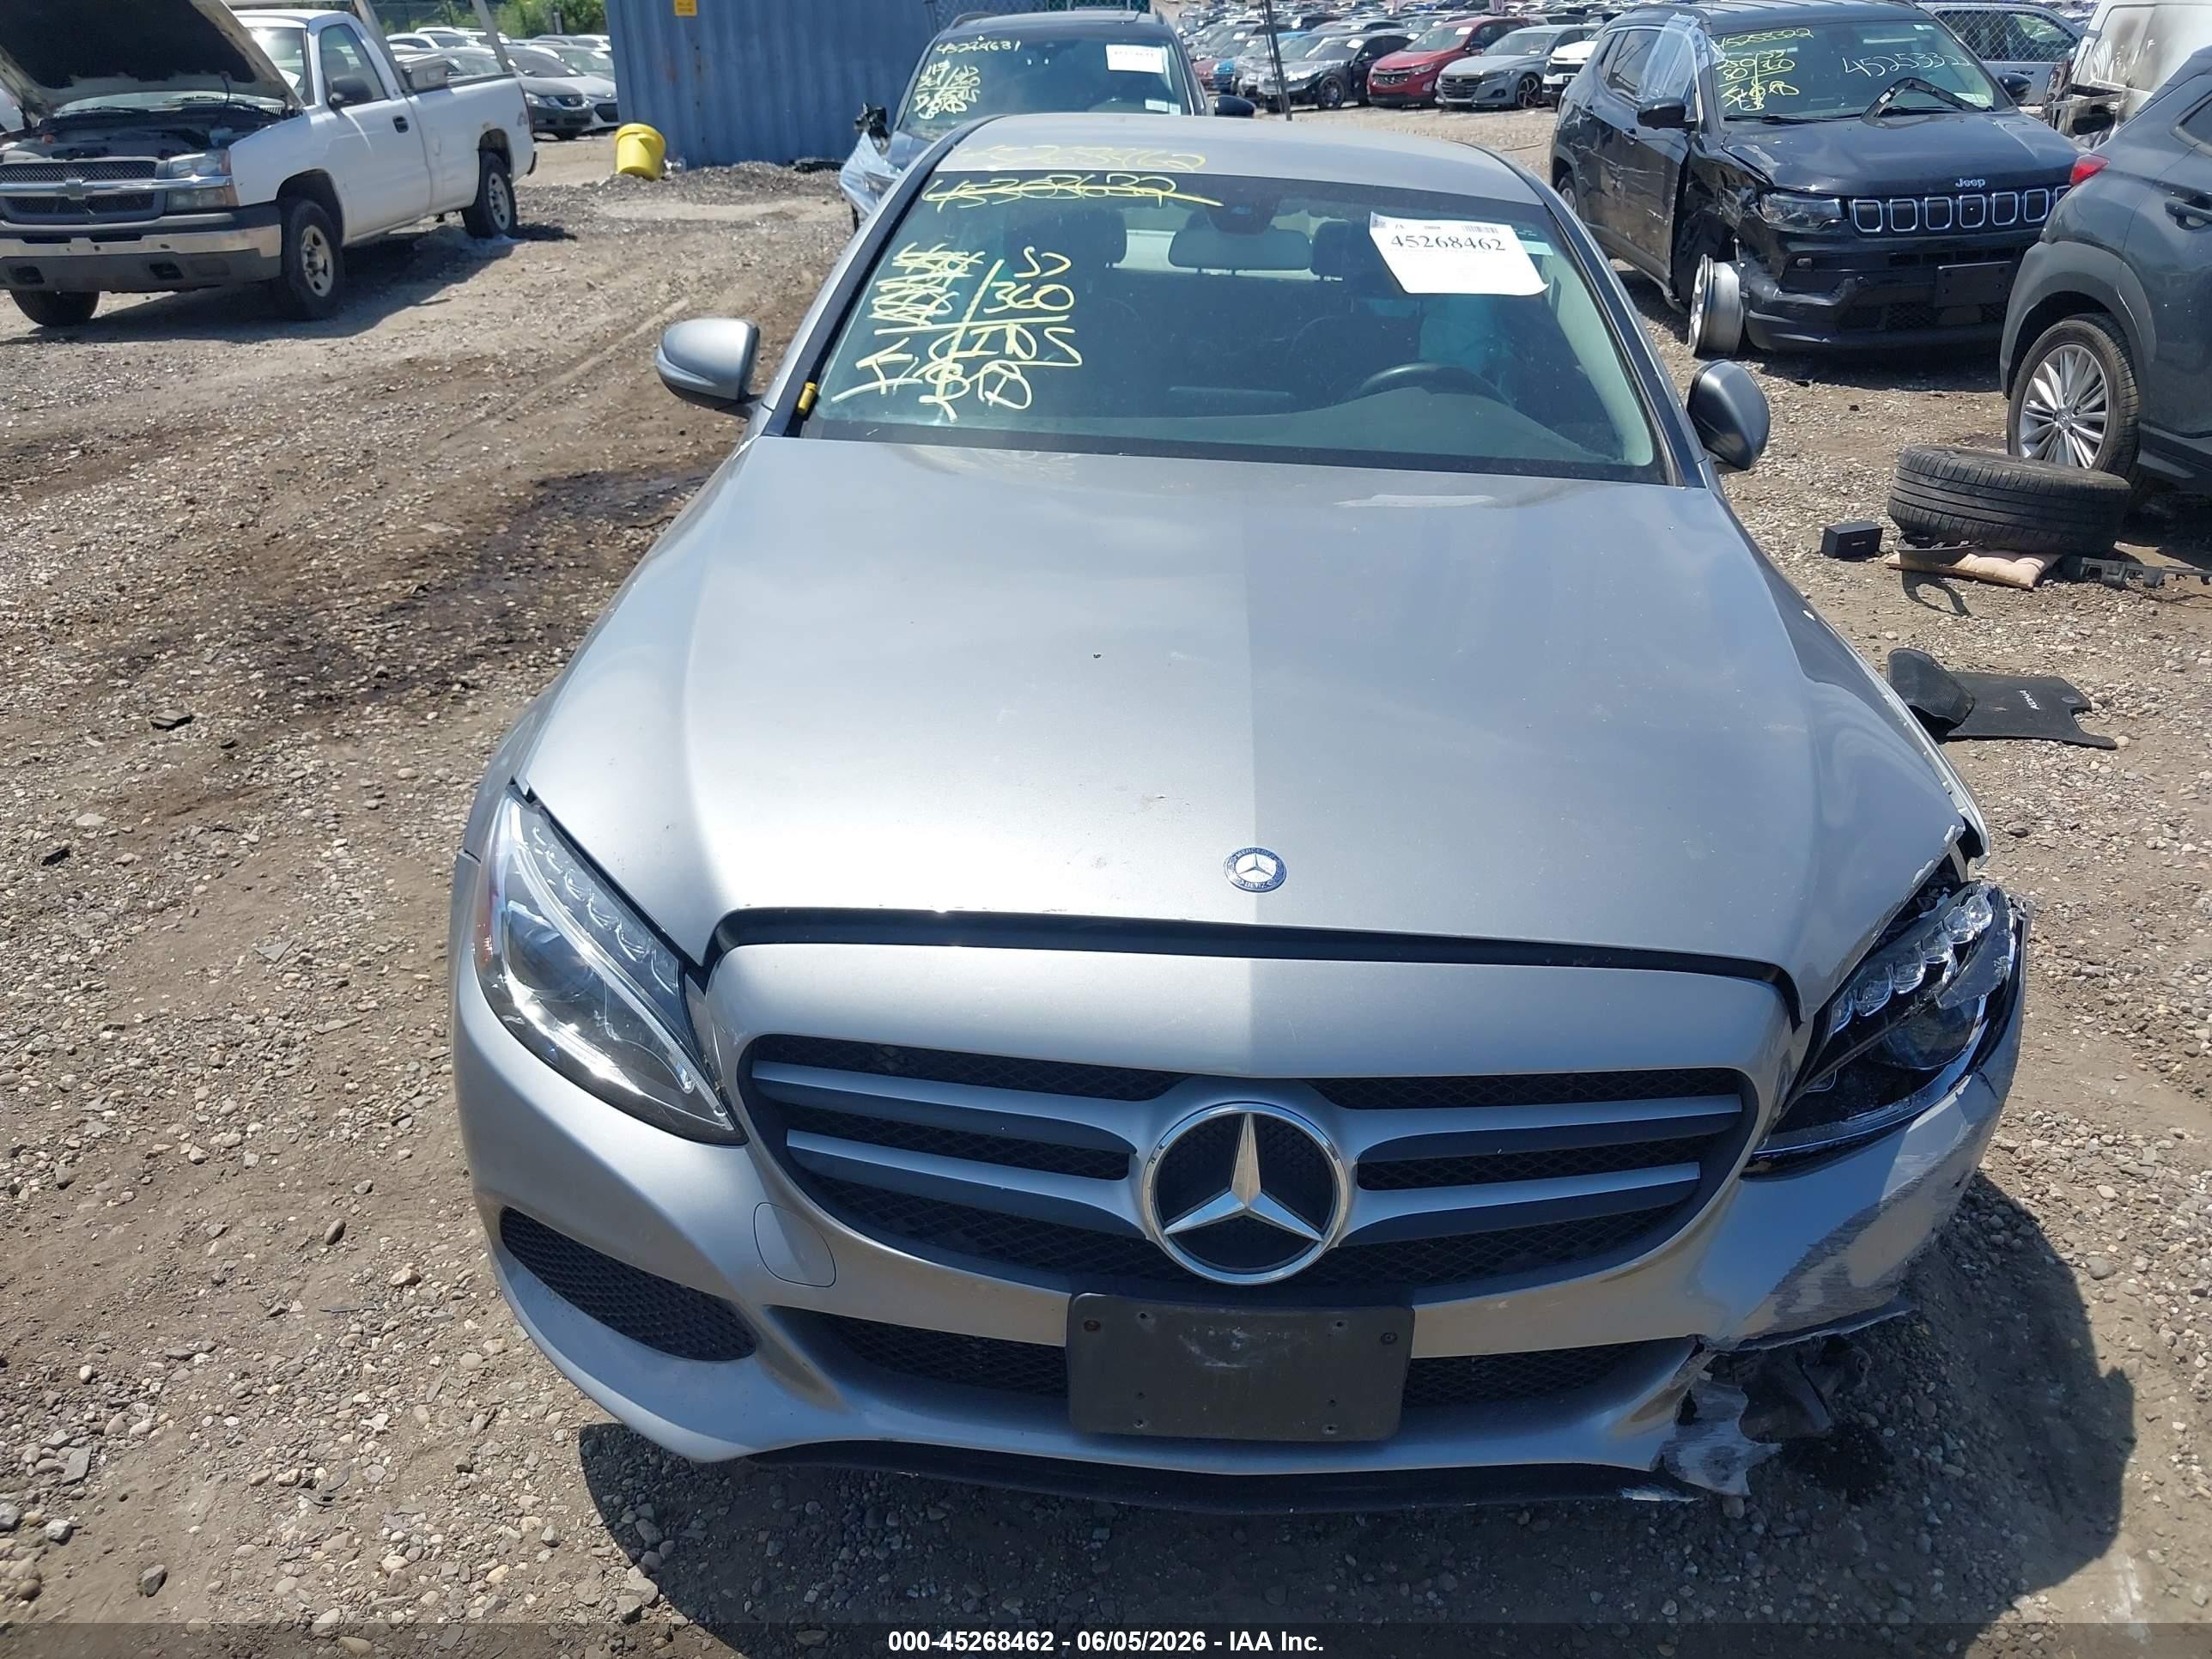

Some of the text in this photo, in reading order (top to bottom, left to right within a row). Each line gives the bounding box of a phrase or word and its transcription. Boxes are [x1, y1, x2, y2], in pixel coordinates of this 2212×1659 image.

[1842, 52, 1976, 77] 45253322
[1954, 178, 1986, 188] Jeep
[1390, 234, 1505, 252] 45268462
[983, 283, 1074, 313] 360
